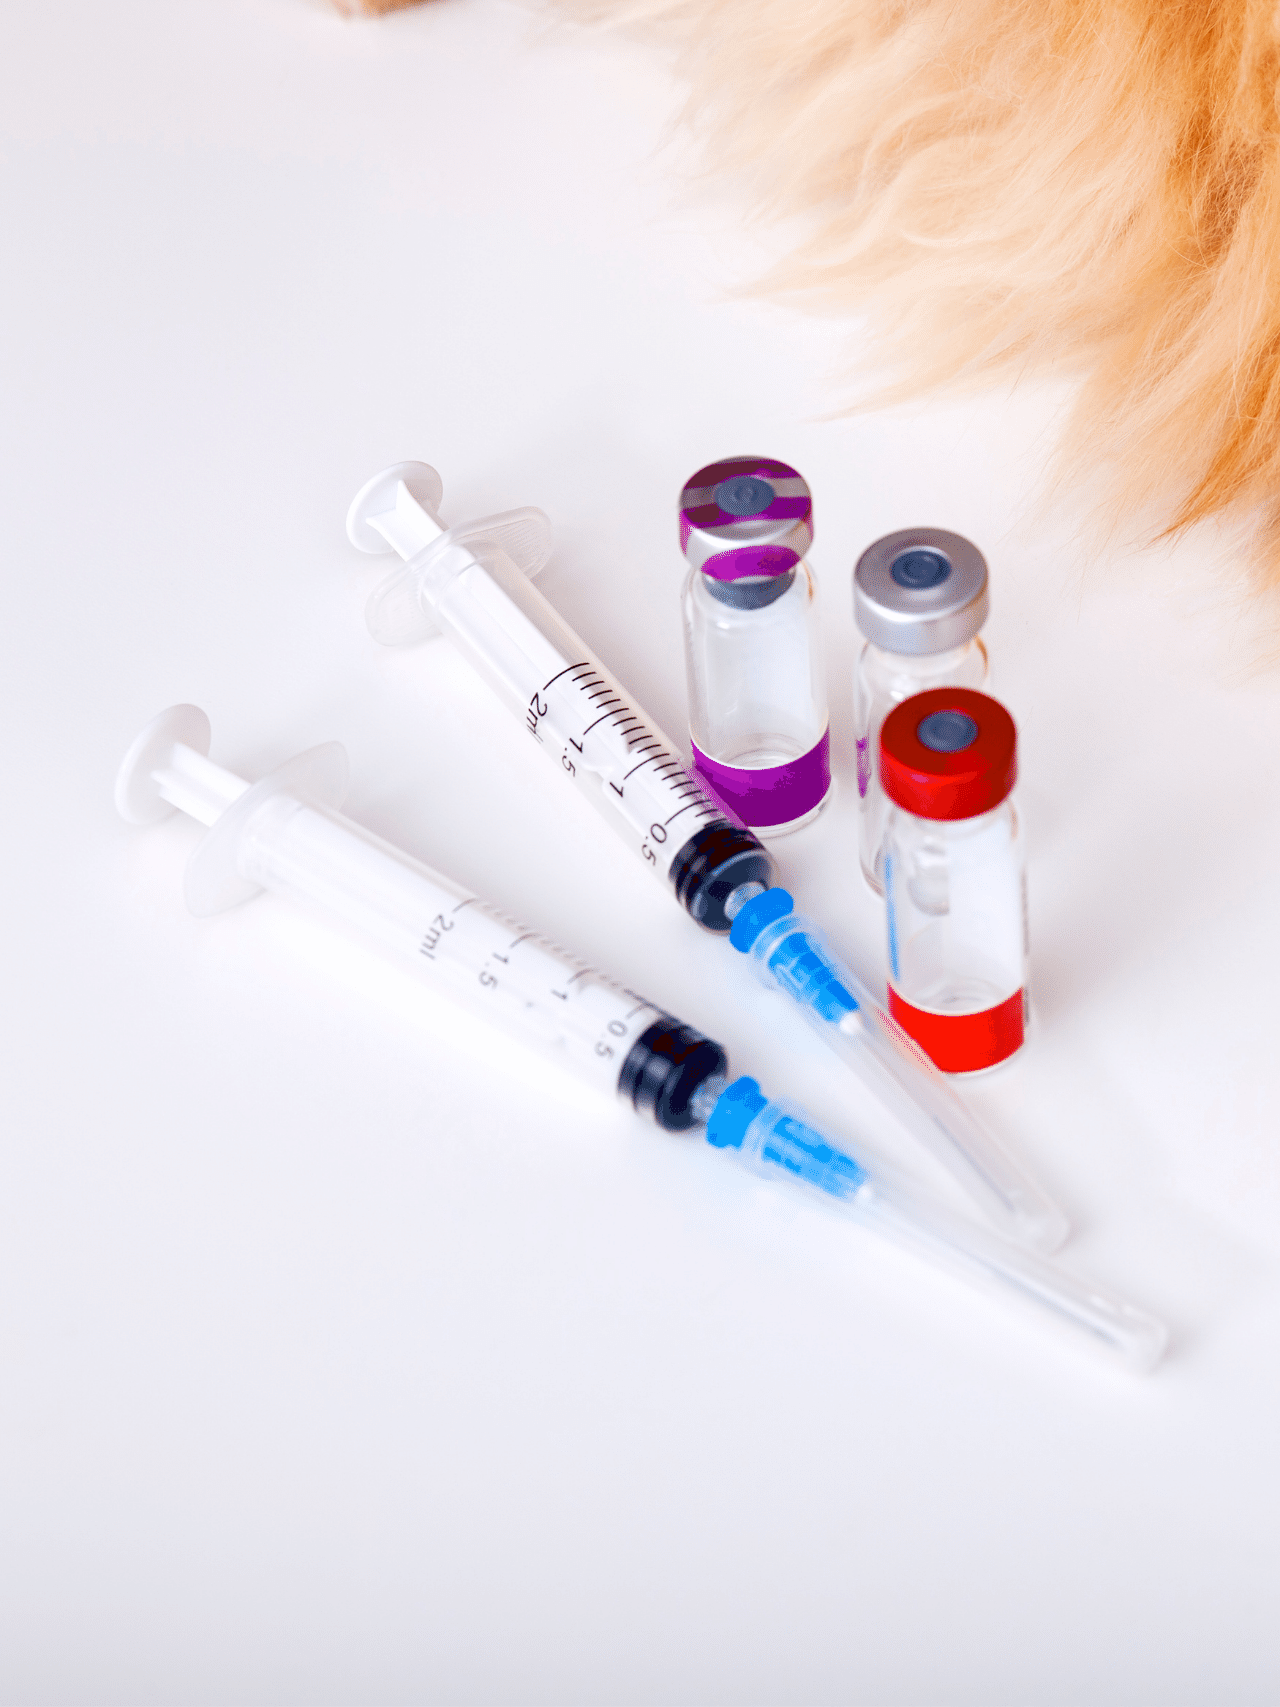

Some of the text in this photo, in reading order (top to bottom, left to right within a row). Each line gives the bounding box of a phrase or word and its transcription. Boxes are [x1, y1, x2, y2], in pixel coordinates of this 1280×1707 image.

[561, 737, 584, 778] 1.5
[609, 781, 624, 798] 1
[640, 823, 668, 866] 0.5
[419, 914, 454, 960] 2ml
[478, 952, 510, 990] 1.5
[550, 988, 568, 1001] 1
[593, 1019, 629, 1061] 0.5
